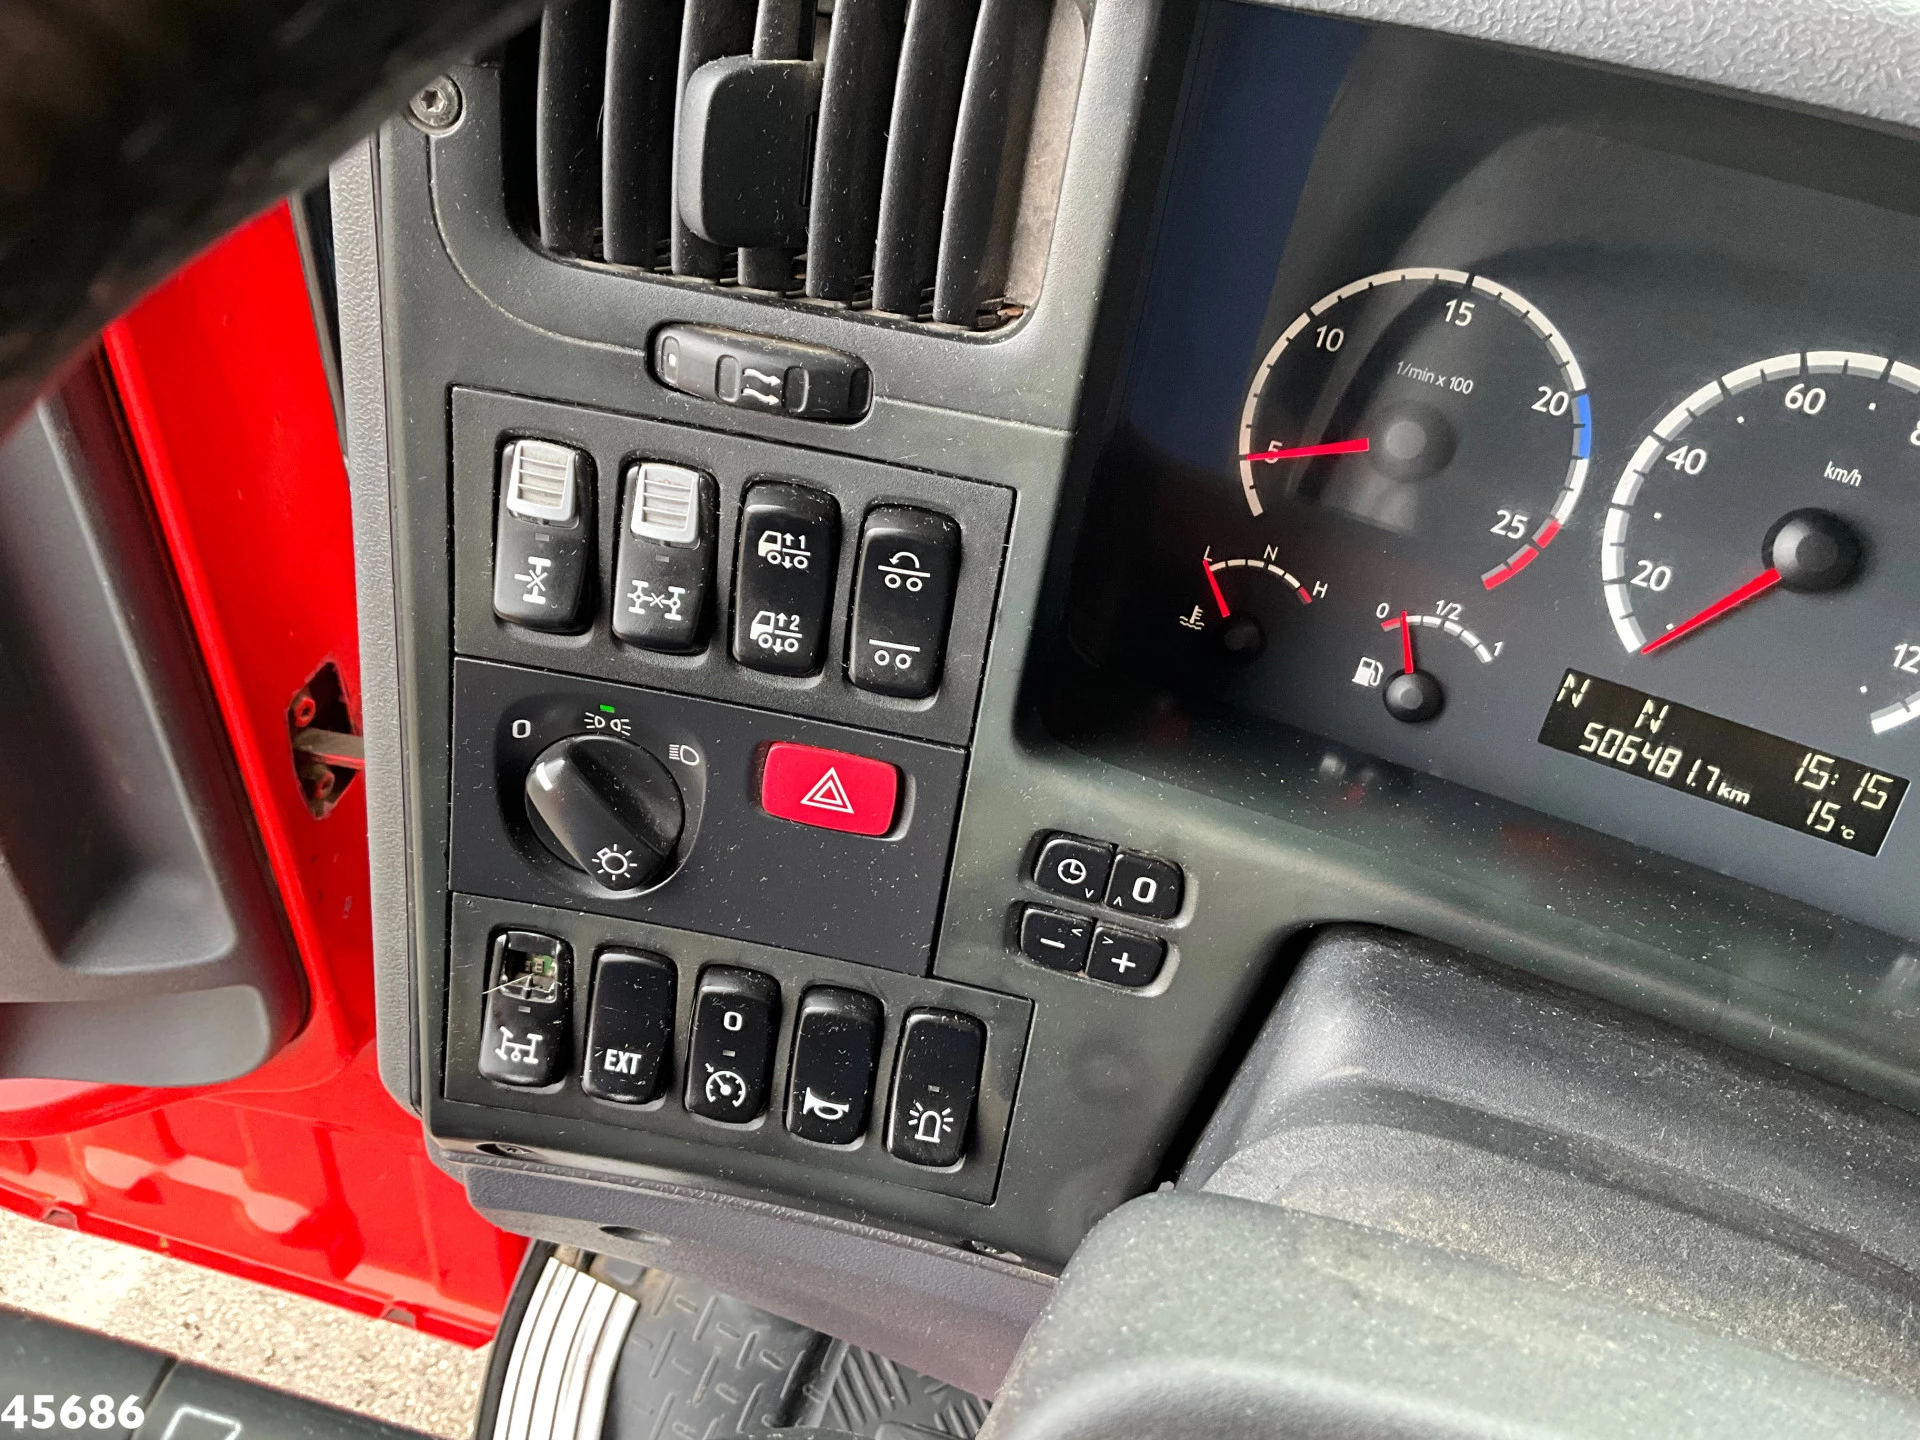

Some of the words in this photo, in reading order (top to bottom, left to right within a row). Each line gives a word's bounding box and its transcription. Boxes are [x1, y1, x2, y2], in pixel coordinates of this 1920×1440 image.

[1445, 299, 1475, 327] 15
[1316, 325, 1344, 352] 10
[1397, 361, 1435, 384] 1/min
[1449, 376, 1474, 395] 100
[1531, 385, 1570, 416] 20
[1784, 383, 1826, 415] 60
[1264, 440, 1283, 464] 5
[1665, 445, 1707, 475] 40
[1823, 461, 1862, 487] km/h
[1489, 509, 1529, 540] 25
[1263, 544, 1279, 561] N
[1629, 559, 1672, 592] 20
[1312, 580, 1328, 599] H
[1375, 602, 1390, 619] 0
[1434, 599, 1462, 621] 1/2
[1493, 640, 1504, 657] 1
[1556, 673, 1591, 708] N
[1634, 699, 1669, 734] N
[603, 1048, 641, 1075] EXT
